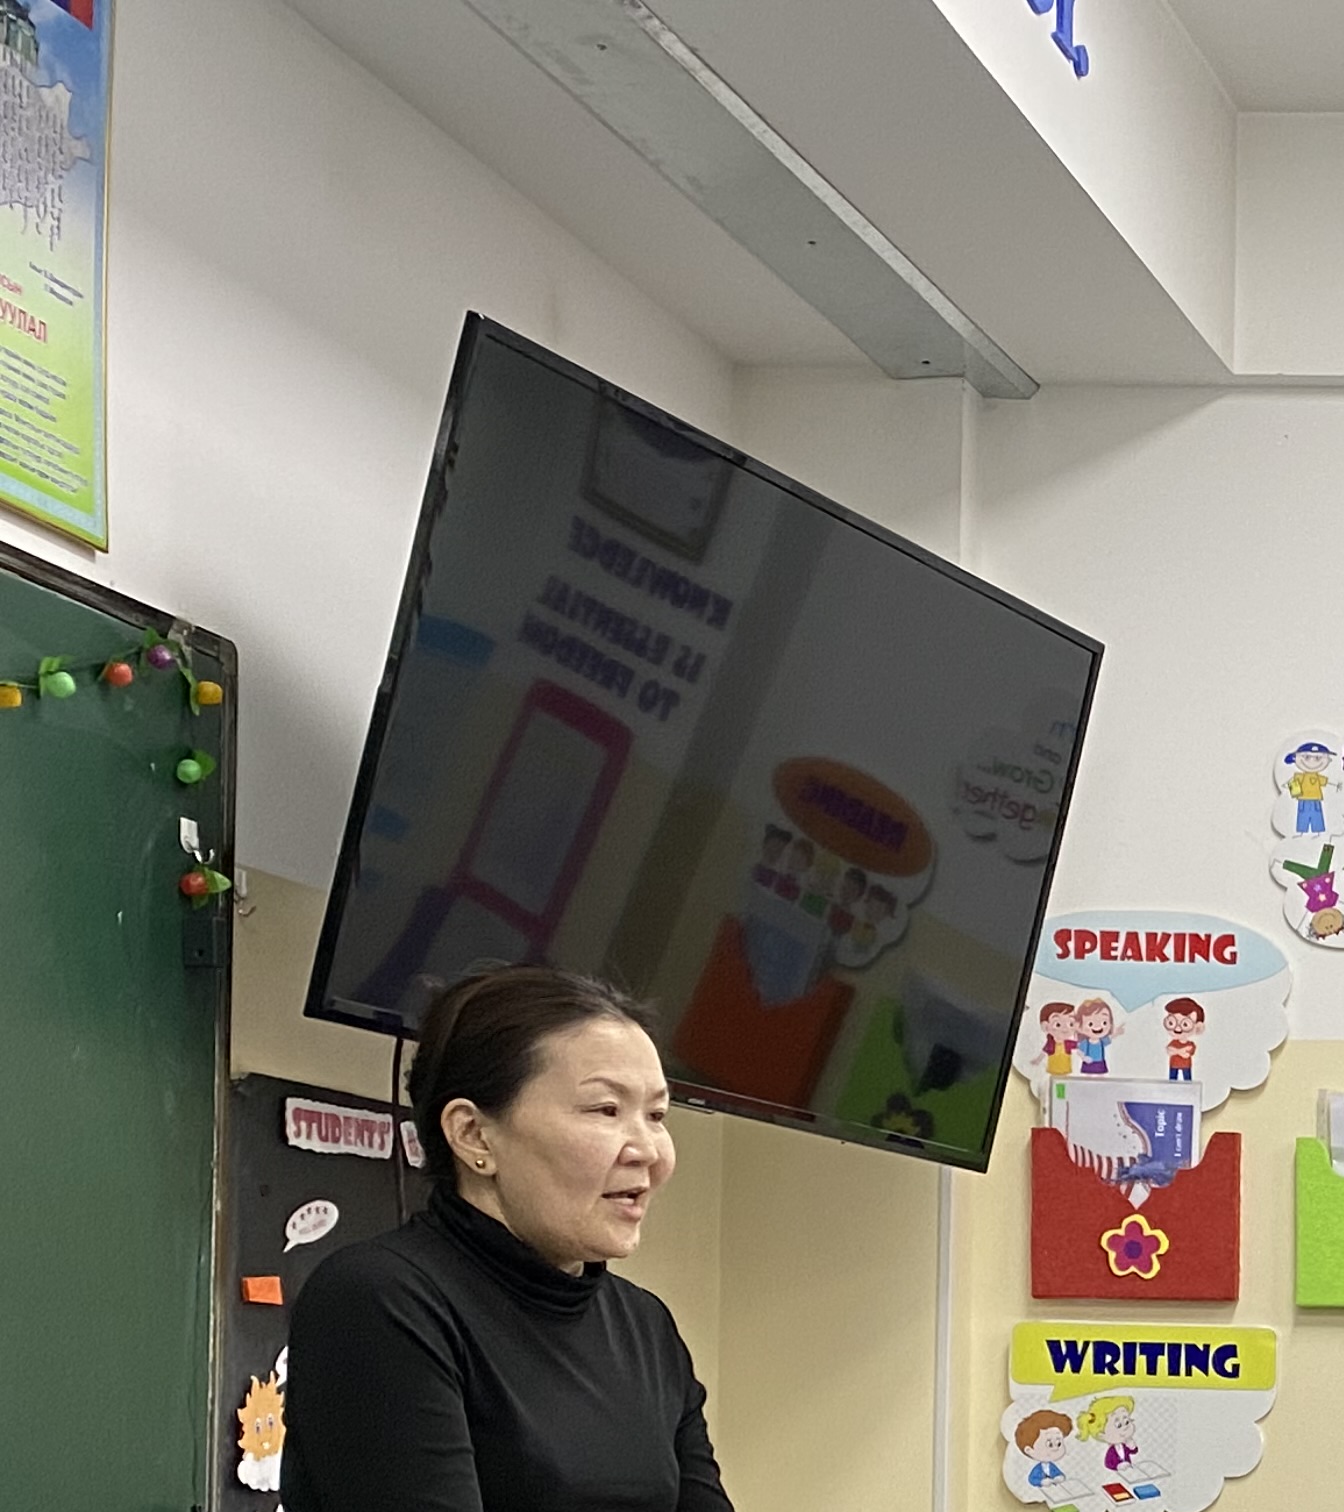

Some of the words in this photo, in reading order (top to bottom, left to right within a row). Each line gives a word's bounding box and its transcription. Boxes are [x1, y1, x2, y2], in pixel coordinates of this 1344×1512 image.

[1052, 928, 1239, 965] SPEAKING
[1155, 1109, 1167, 1137] Topic
[1045, 1339, 1241, 1379] WRITING
